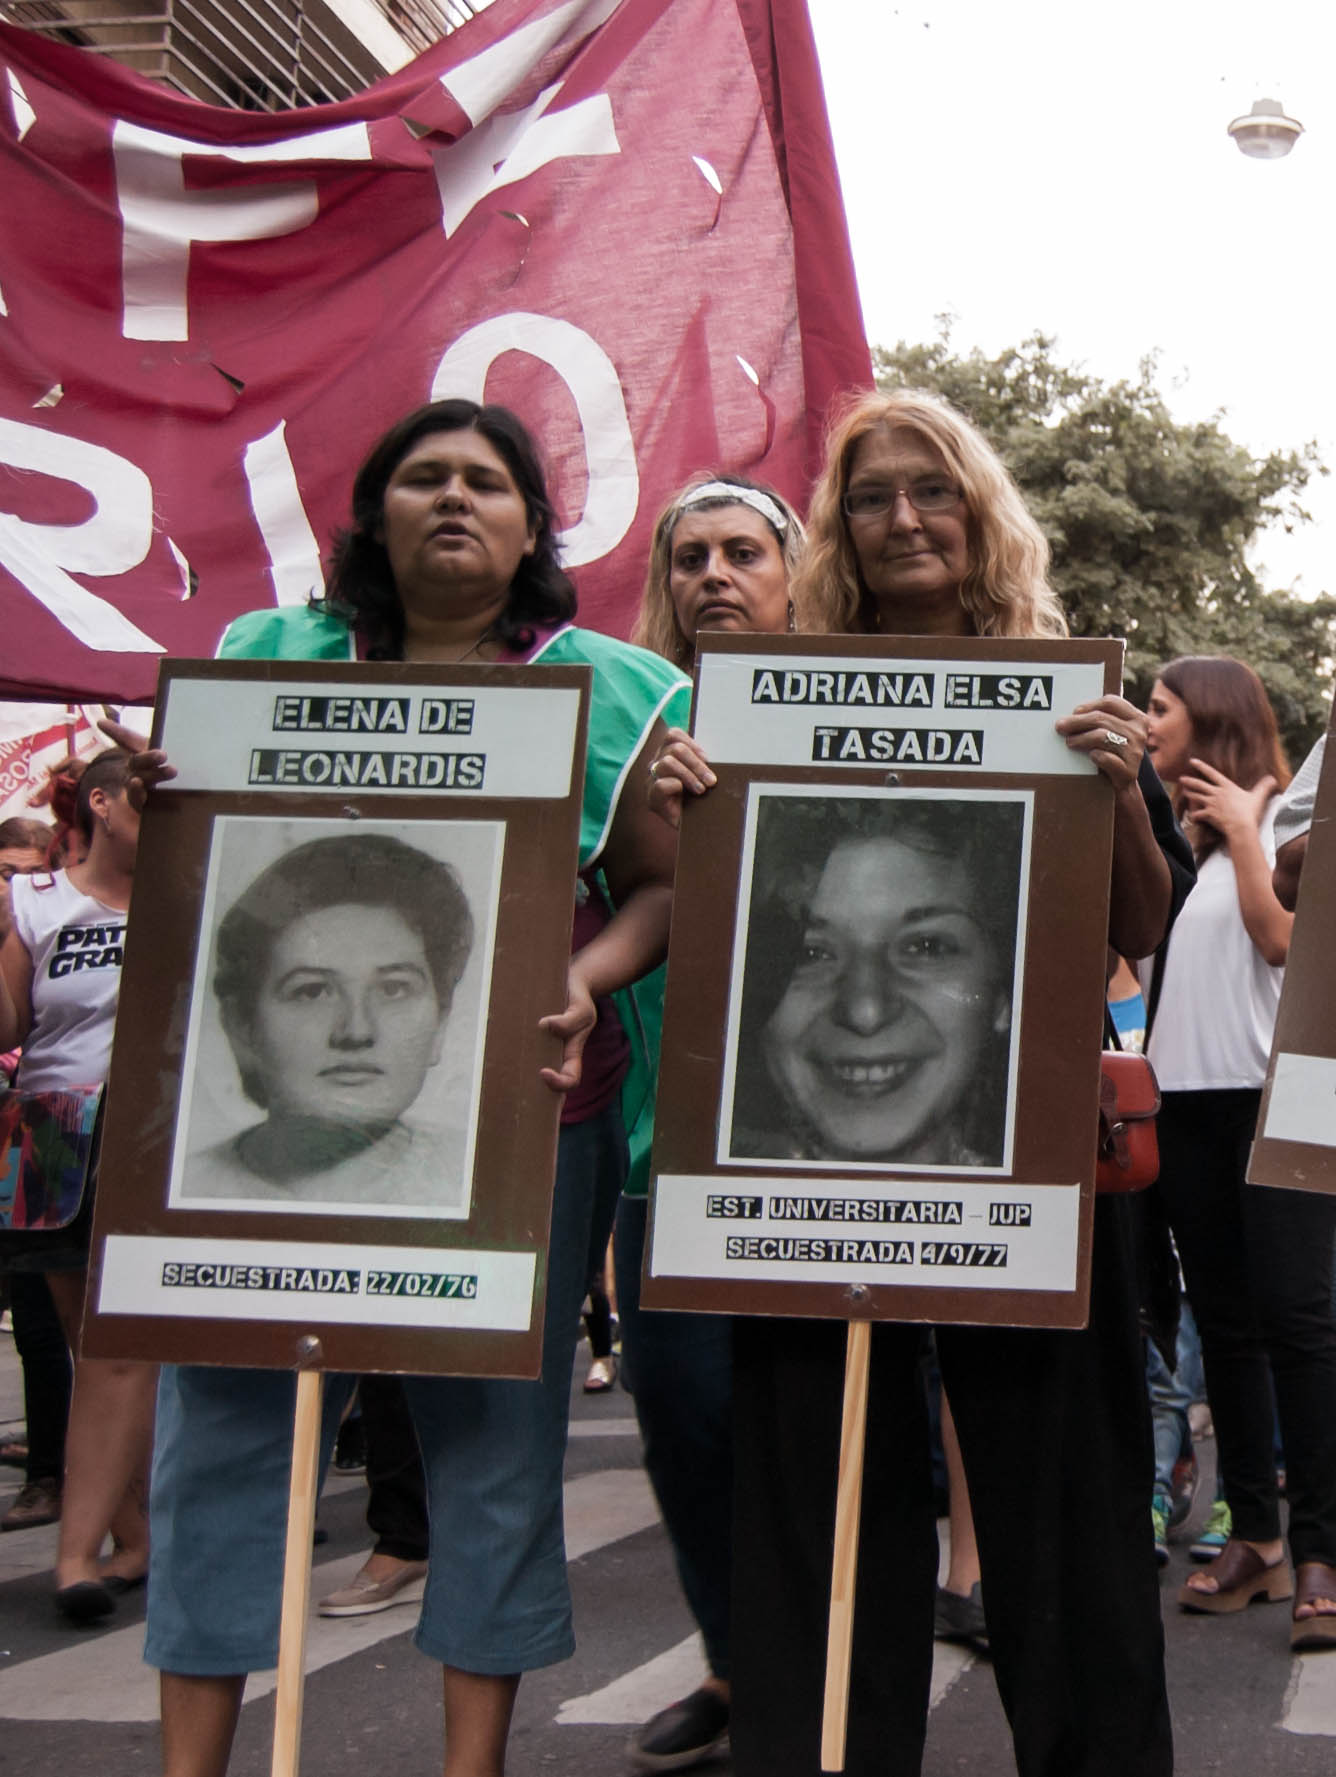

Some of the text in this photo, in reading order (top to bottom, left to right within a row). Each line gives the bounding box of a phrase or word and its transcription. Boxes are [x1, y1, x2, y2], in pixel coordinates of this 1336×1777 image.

[752, 670, 1051, 709] ADRIANA ELSA
[274, 698, 474, 733] ELENA DE
[814, 728, 982, 763] TASADA
[249, 751, 485, 787] LEONARDIS
[707, 1196, 762, 1217] EST.
[769, 1198, 962, 1224] UNIVERSITARIA
[989, 1204, 1031, 1226] JUP
[727, 1237, 1008, 1266] SECUESTRADA 4/9/77
[163, 1263, 477, 1298] SECUESTRADA: 22/02/76
